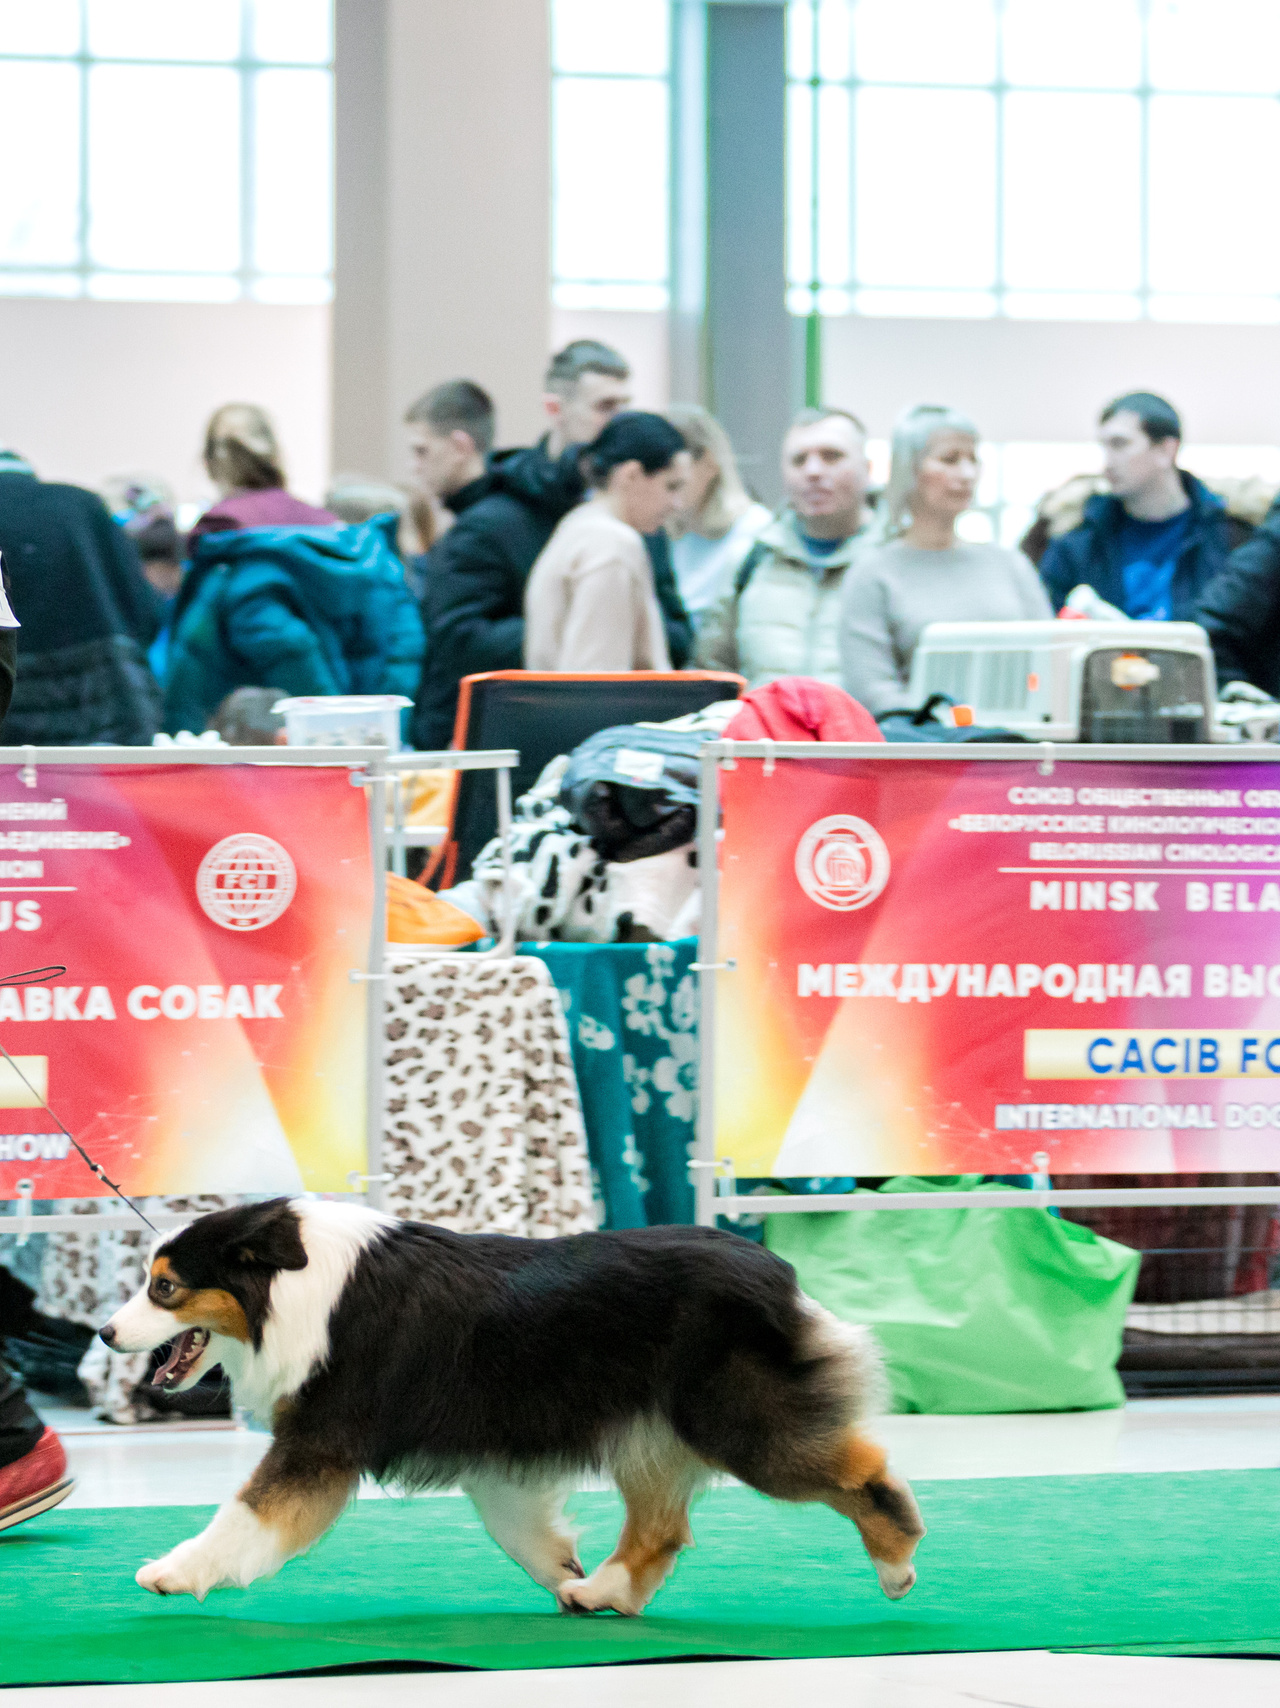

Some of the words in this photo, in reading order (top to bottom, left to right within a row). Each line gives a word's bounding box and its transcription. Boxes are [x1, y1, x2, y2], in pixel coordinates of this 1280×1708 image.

[224, 872, 266, 889] FCI
[1029, 881, 1160, 911] MINSK
[1185, 882, 1280, 912] BELA
[797, 963, 1192, 1003] МЕЖДУНАРОДНАЯ
[127, 984, 284, 1020] СОБАК
[1087, 1037, 1220, 1074] CACIB
[995, 1103, 1216, 1130] INTERNATIONAL
